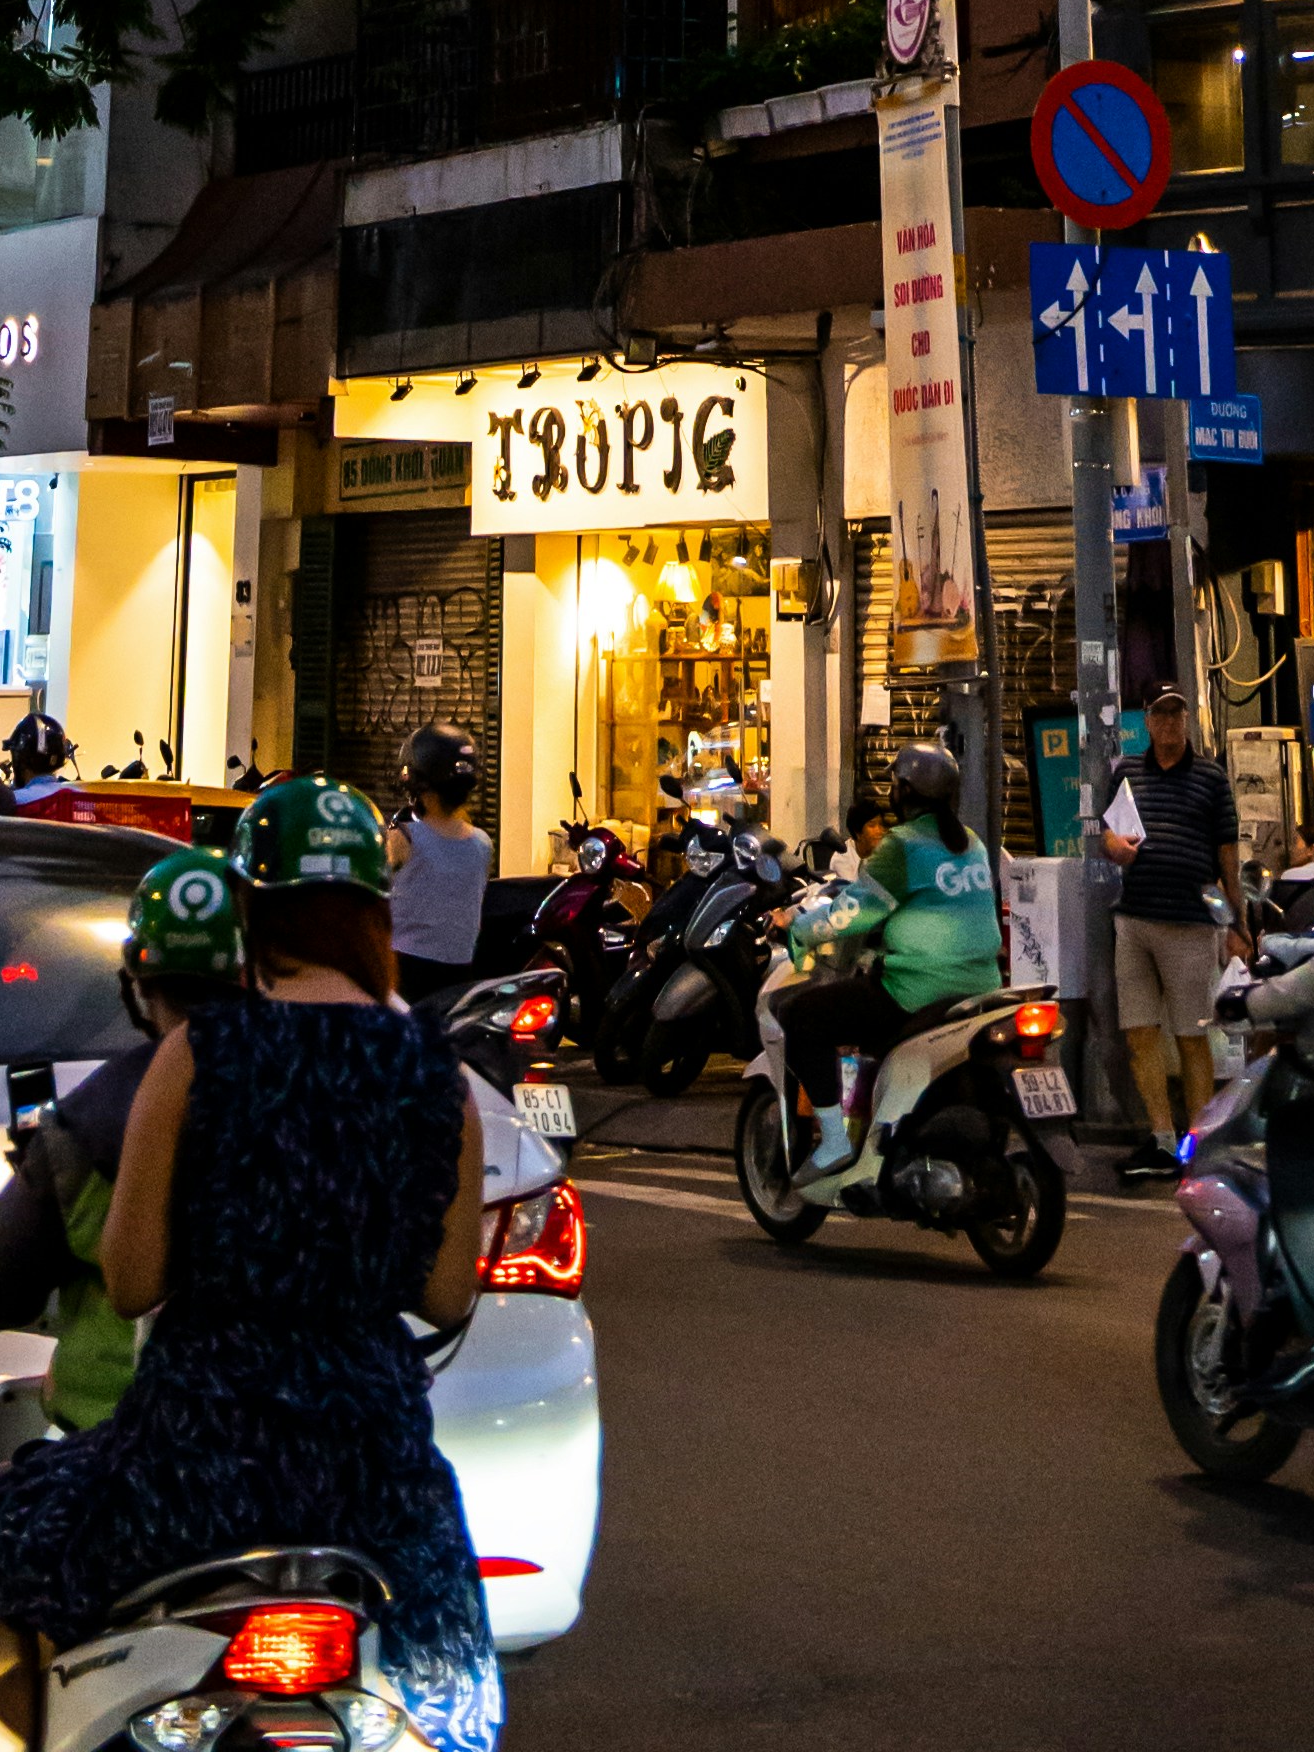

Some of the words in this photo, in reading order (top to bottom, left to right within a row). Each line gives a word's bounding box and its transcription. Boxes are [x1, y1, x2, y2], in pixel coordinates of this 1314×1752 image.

[911, 330, 931, 358] CHO
[487, 395, 737, 502] TROPIC
[936, 862, 993, 896] Gra
